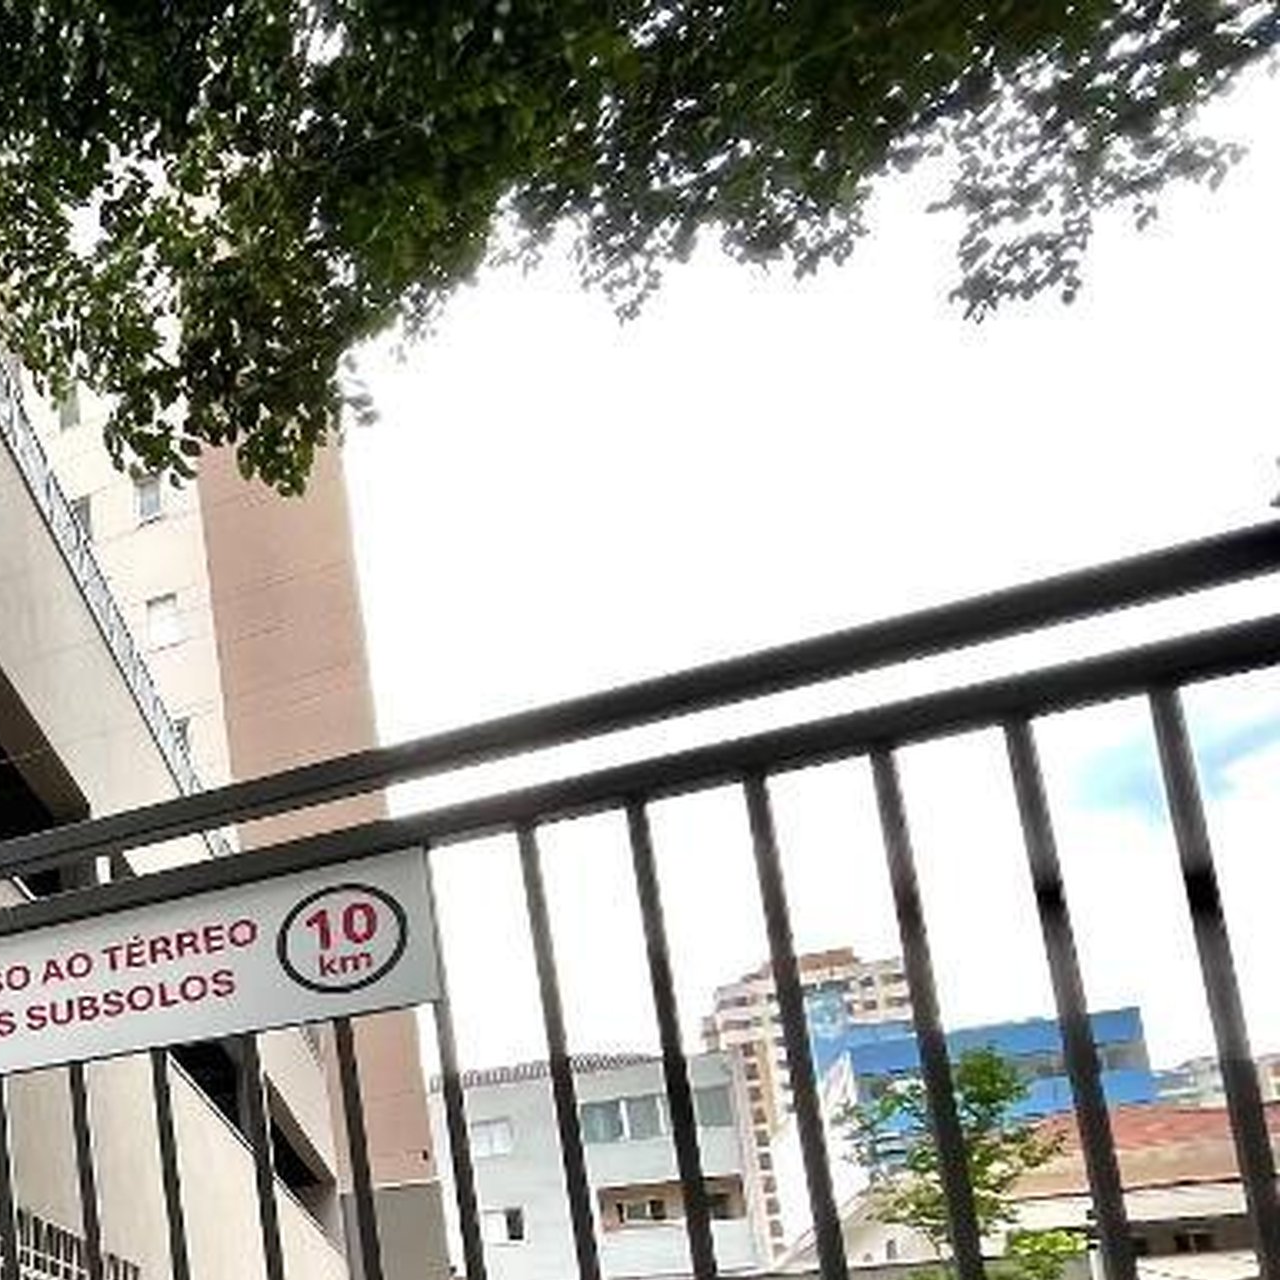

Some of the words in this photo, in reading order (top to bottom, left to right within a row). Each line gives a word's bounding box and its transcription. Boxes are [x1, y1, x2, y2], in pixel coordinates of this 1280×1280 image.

[42, 952, 93, 986] AO
[103, 918, 258, 973] TÉRREO
[305, 901, 379, 952] 10
[318, 948, 374, 979] km
[26, 969, 237, 1031] SUBSOLOS
